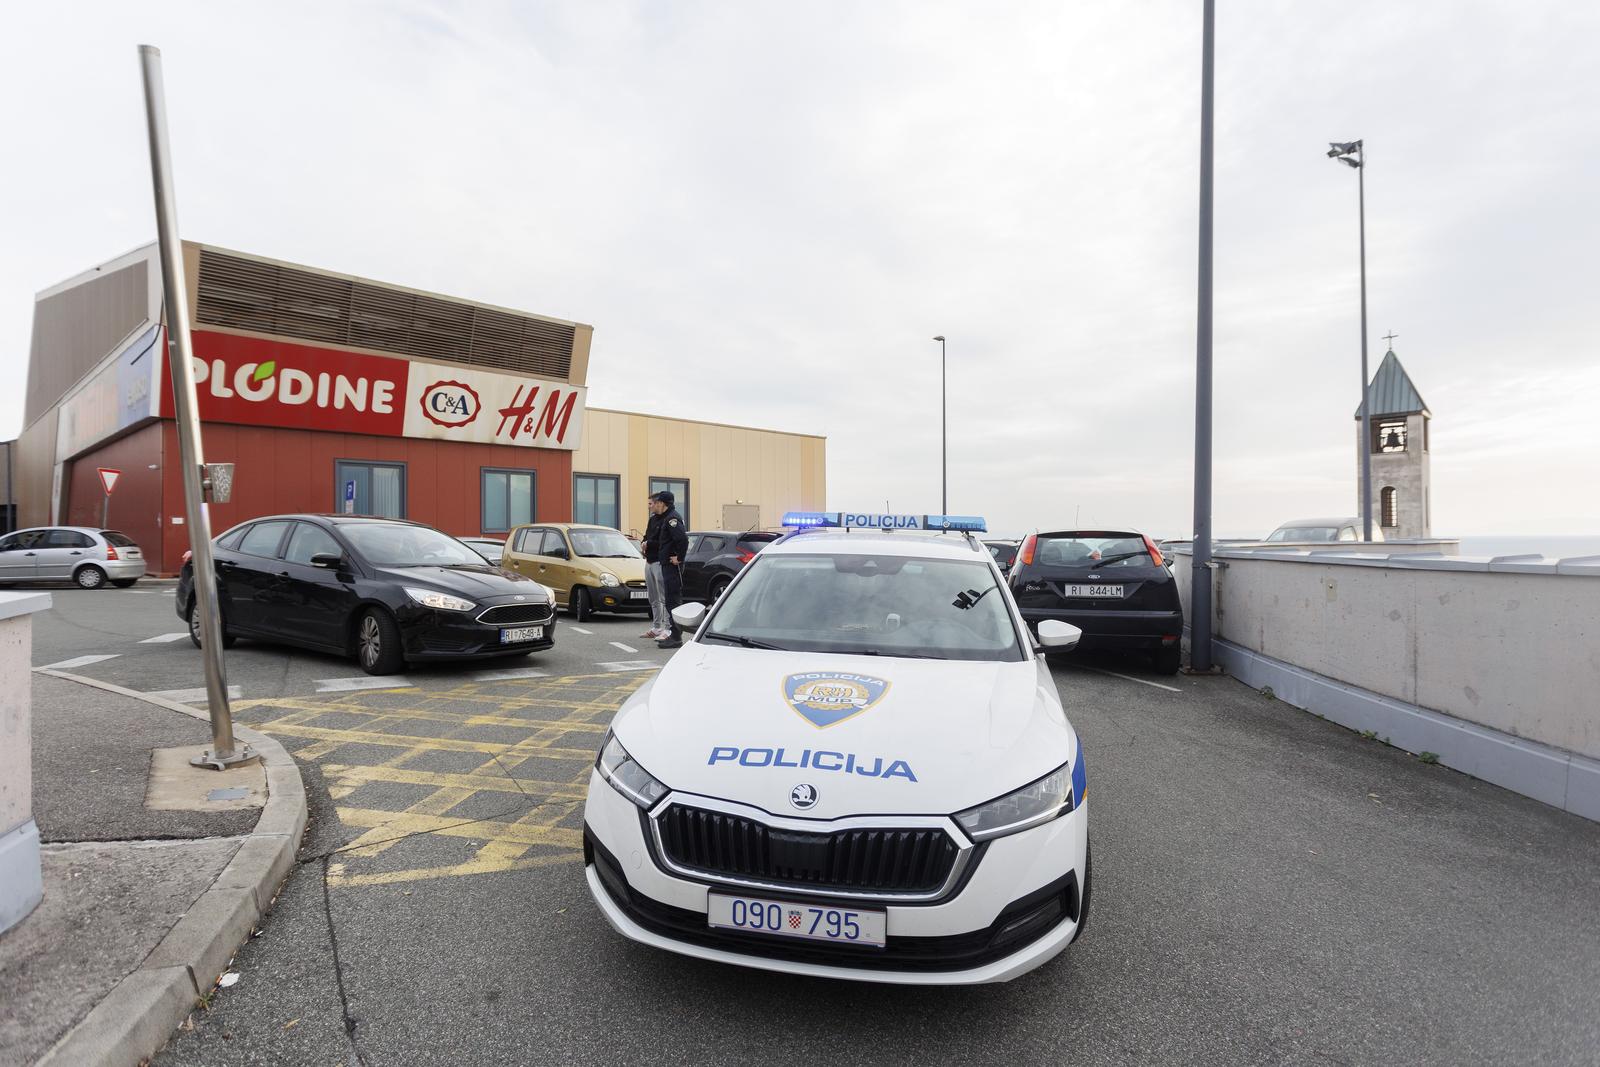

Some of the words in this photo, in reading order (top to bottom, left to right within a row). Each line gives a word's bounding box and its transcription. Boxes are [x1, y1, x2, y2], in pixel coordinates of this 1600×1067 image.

[431, 391, 470, 416] C&A
[496, 384, 578, 444] H&M
[845, 514, 918, 528] POLICIJA
[1071, 586, 1082, 595] RI
[1089, 586, 1122, 595] 844-LM
[505, 630, 513, 640] RI
[792, 673, 884, 686] POLICIJA
[707, 746, 918, 783] POLICIJA
[732, 899, 782, 931] 090
[808, 908, 859, 940] 795
